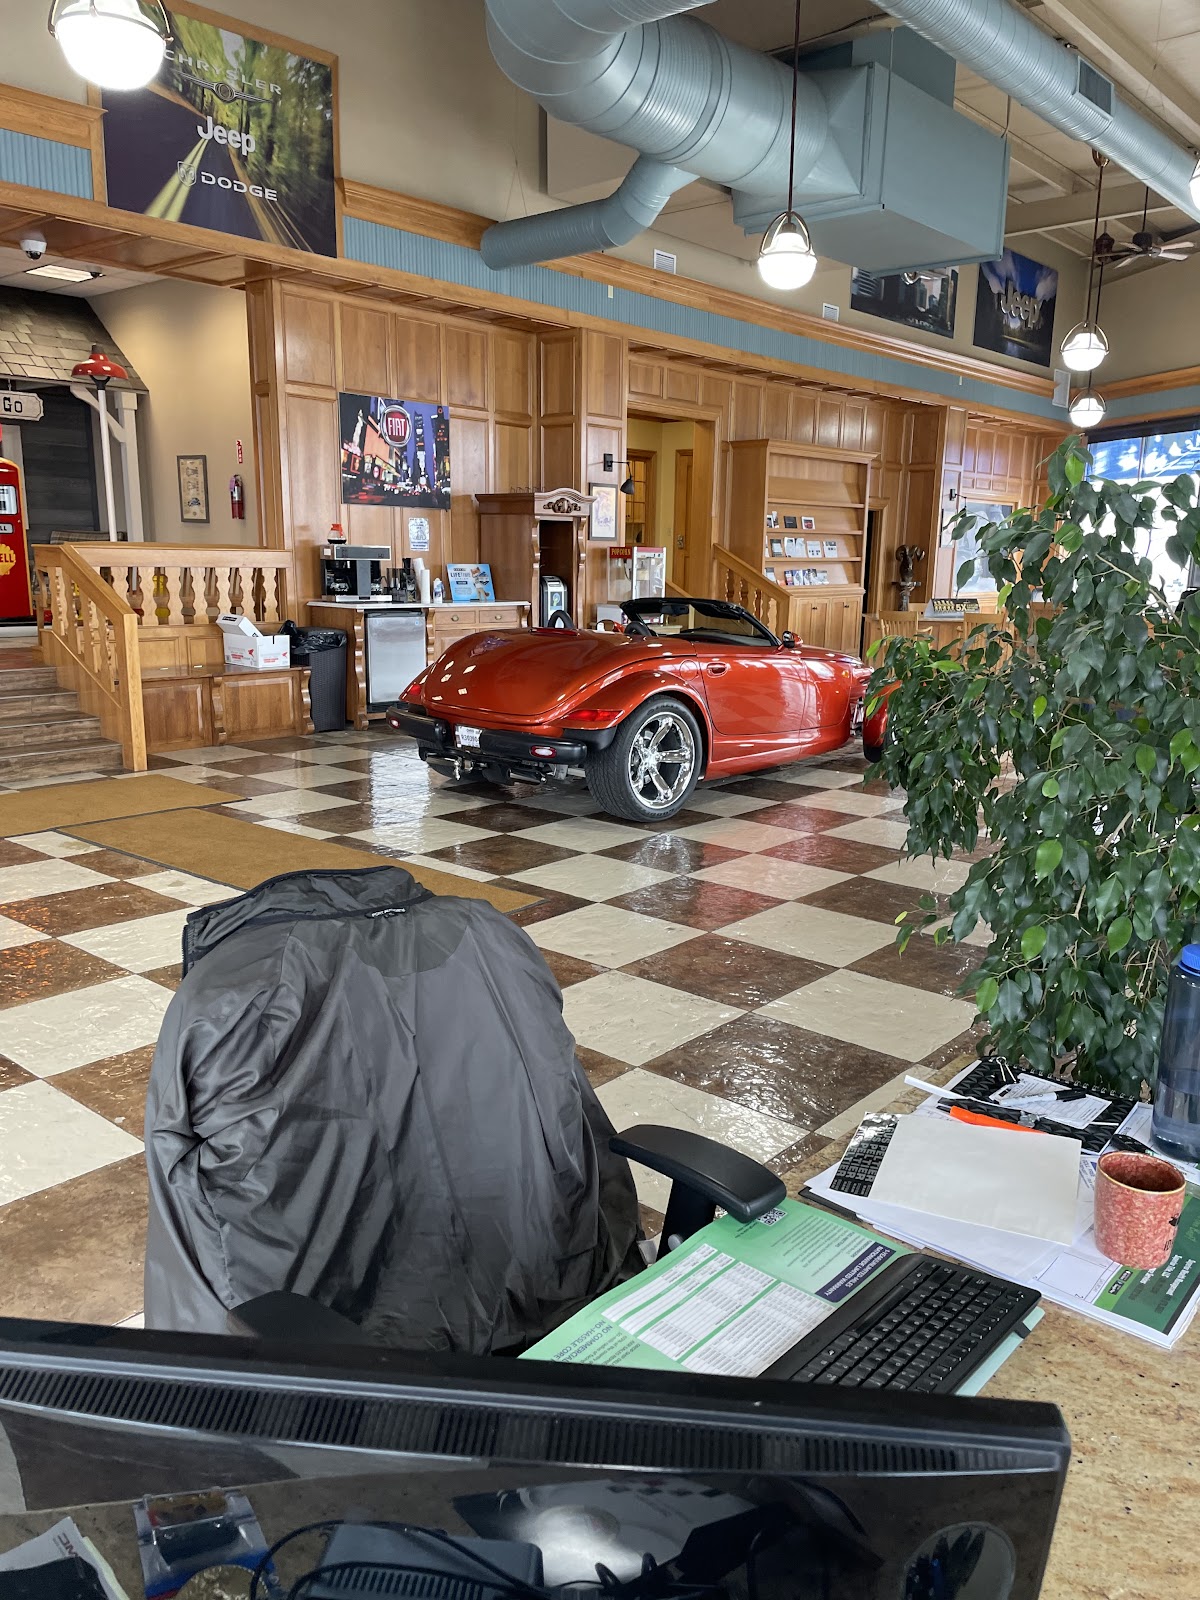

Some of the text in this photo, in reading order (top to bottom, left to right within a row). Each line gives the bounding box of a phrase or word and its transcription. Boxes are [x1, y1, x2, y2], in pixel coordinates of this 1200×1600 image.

[164, 49, 282, 95] CHRYSLER
[197, 116, 256, 156] Jeep
[201, 171, 278, 202] DODGE
[1000, 280, 1040, 329] Jeep
[388, 417, 406, 436] FIAT
[956, 604, 967, 612] 5X
[836, 1147, 858, 1177] ELTIER
[846, 1142, 868, 1178] PELTIER
[855, 1144, 878, 1180] PELTIER
[864, 1145, 888, 1182] PELTIER
[844, 1264, 862, 1278] LIMITED
[554, 1320, 606, 1360] NO-HASSLE CORE
[602, 1324, 613, 1334] NO
[562, 1333, 602, 1362] COMMERCIAL
